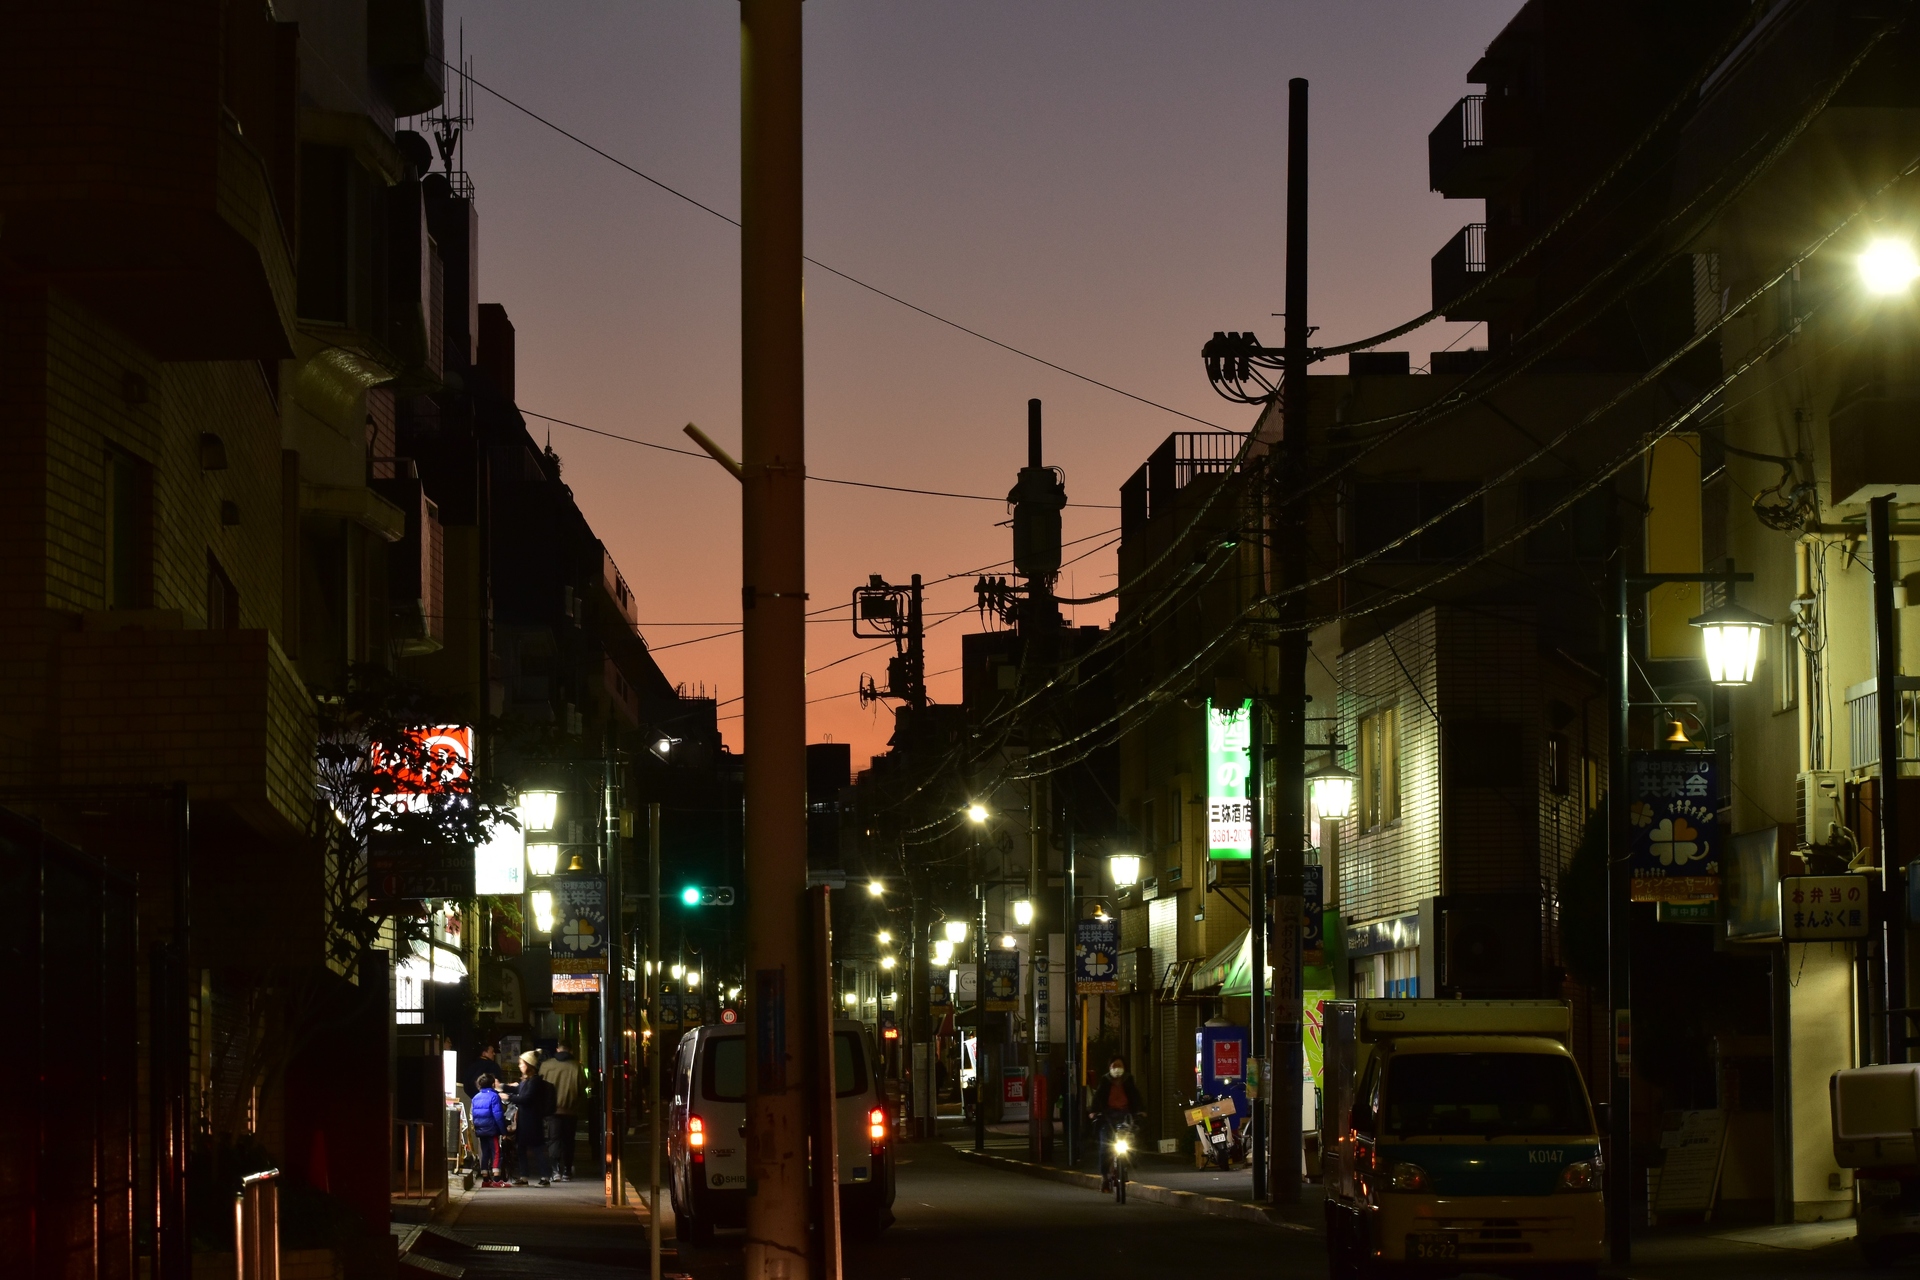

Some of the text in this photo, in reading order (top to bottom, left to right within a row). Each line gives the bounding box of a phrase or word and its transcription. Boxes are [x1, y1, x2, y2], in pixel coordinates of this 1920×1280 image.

[1636, 761, 1710, 774] 東中野本通り
[1639, 774, 1709, 797] 共栄会
[1211, 803, 1251, 823] 三弥酒店
[1634, 876, 1715, 888] ウィンターセール
[1646, 886, 1704, 894] レシートラリー
[1791, 886, 1861, 904] お弁当の
[556, 890, 602, 906] 共栄会
[1670, 907, 1709, 917] 東中野店
[1079, 931, 1114, 943] 共栄会
[553, 958, 606, 966] ウィンターセール
[1280, 924, 1295, 1000] おおくら内科
[725, 1013, 734, 1021] 40
[1007, 1081, 1024, 1098] 酒
[725, 1175, 746, 1183] SHIB
